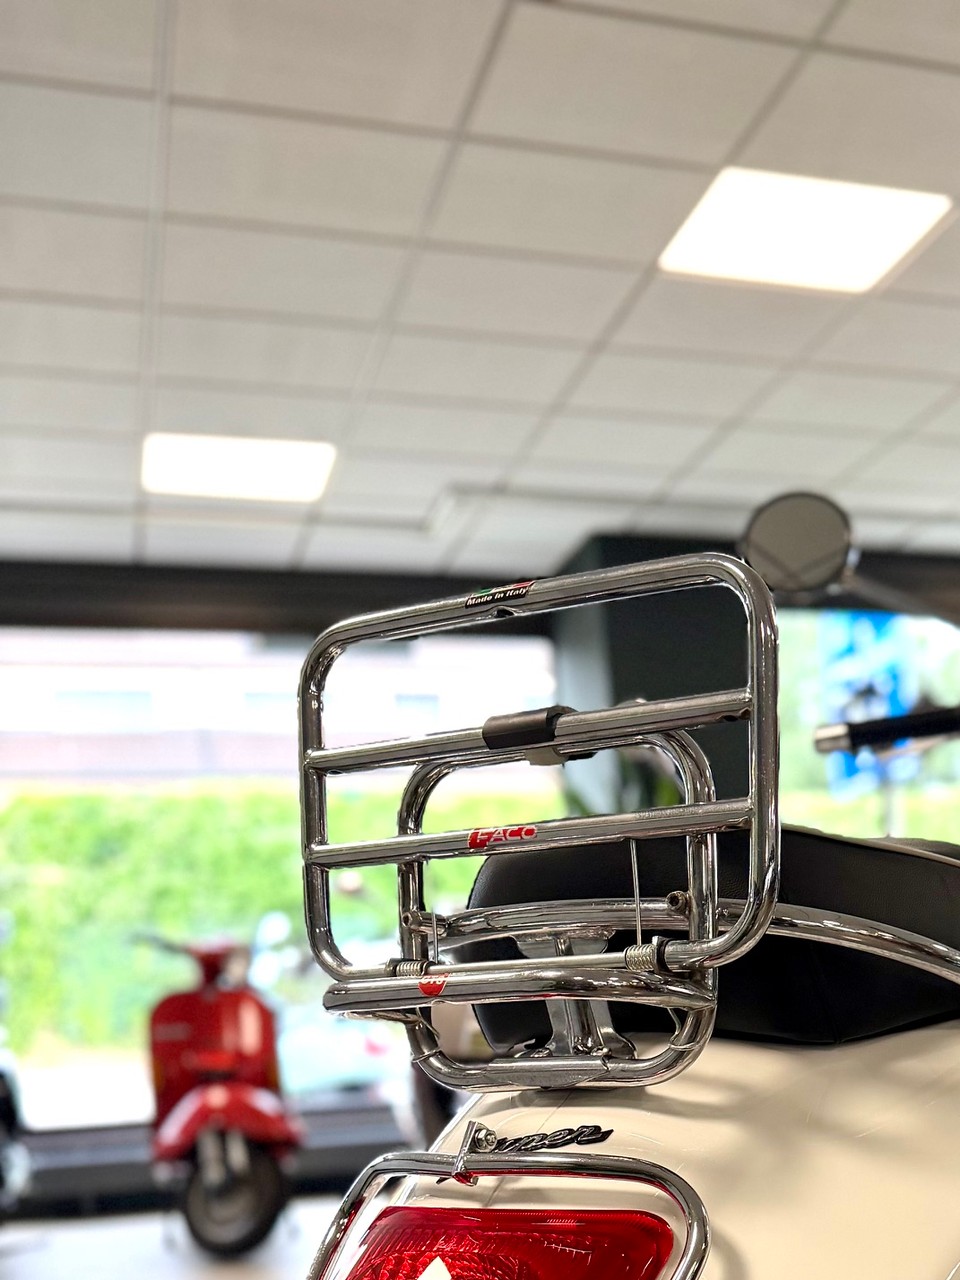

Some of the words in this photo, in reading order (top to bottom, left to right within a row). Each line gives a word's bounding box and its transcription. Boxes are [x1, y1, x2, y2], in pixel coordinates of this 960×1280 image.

[466, 595, 493, 606] Made
[494, 591, 505, 600] in
[506, 586, 529, 597] Italy
[468, 826, 538, 850] FACO
